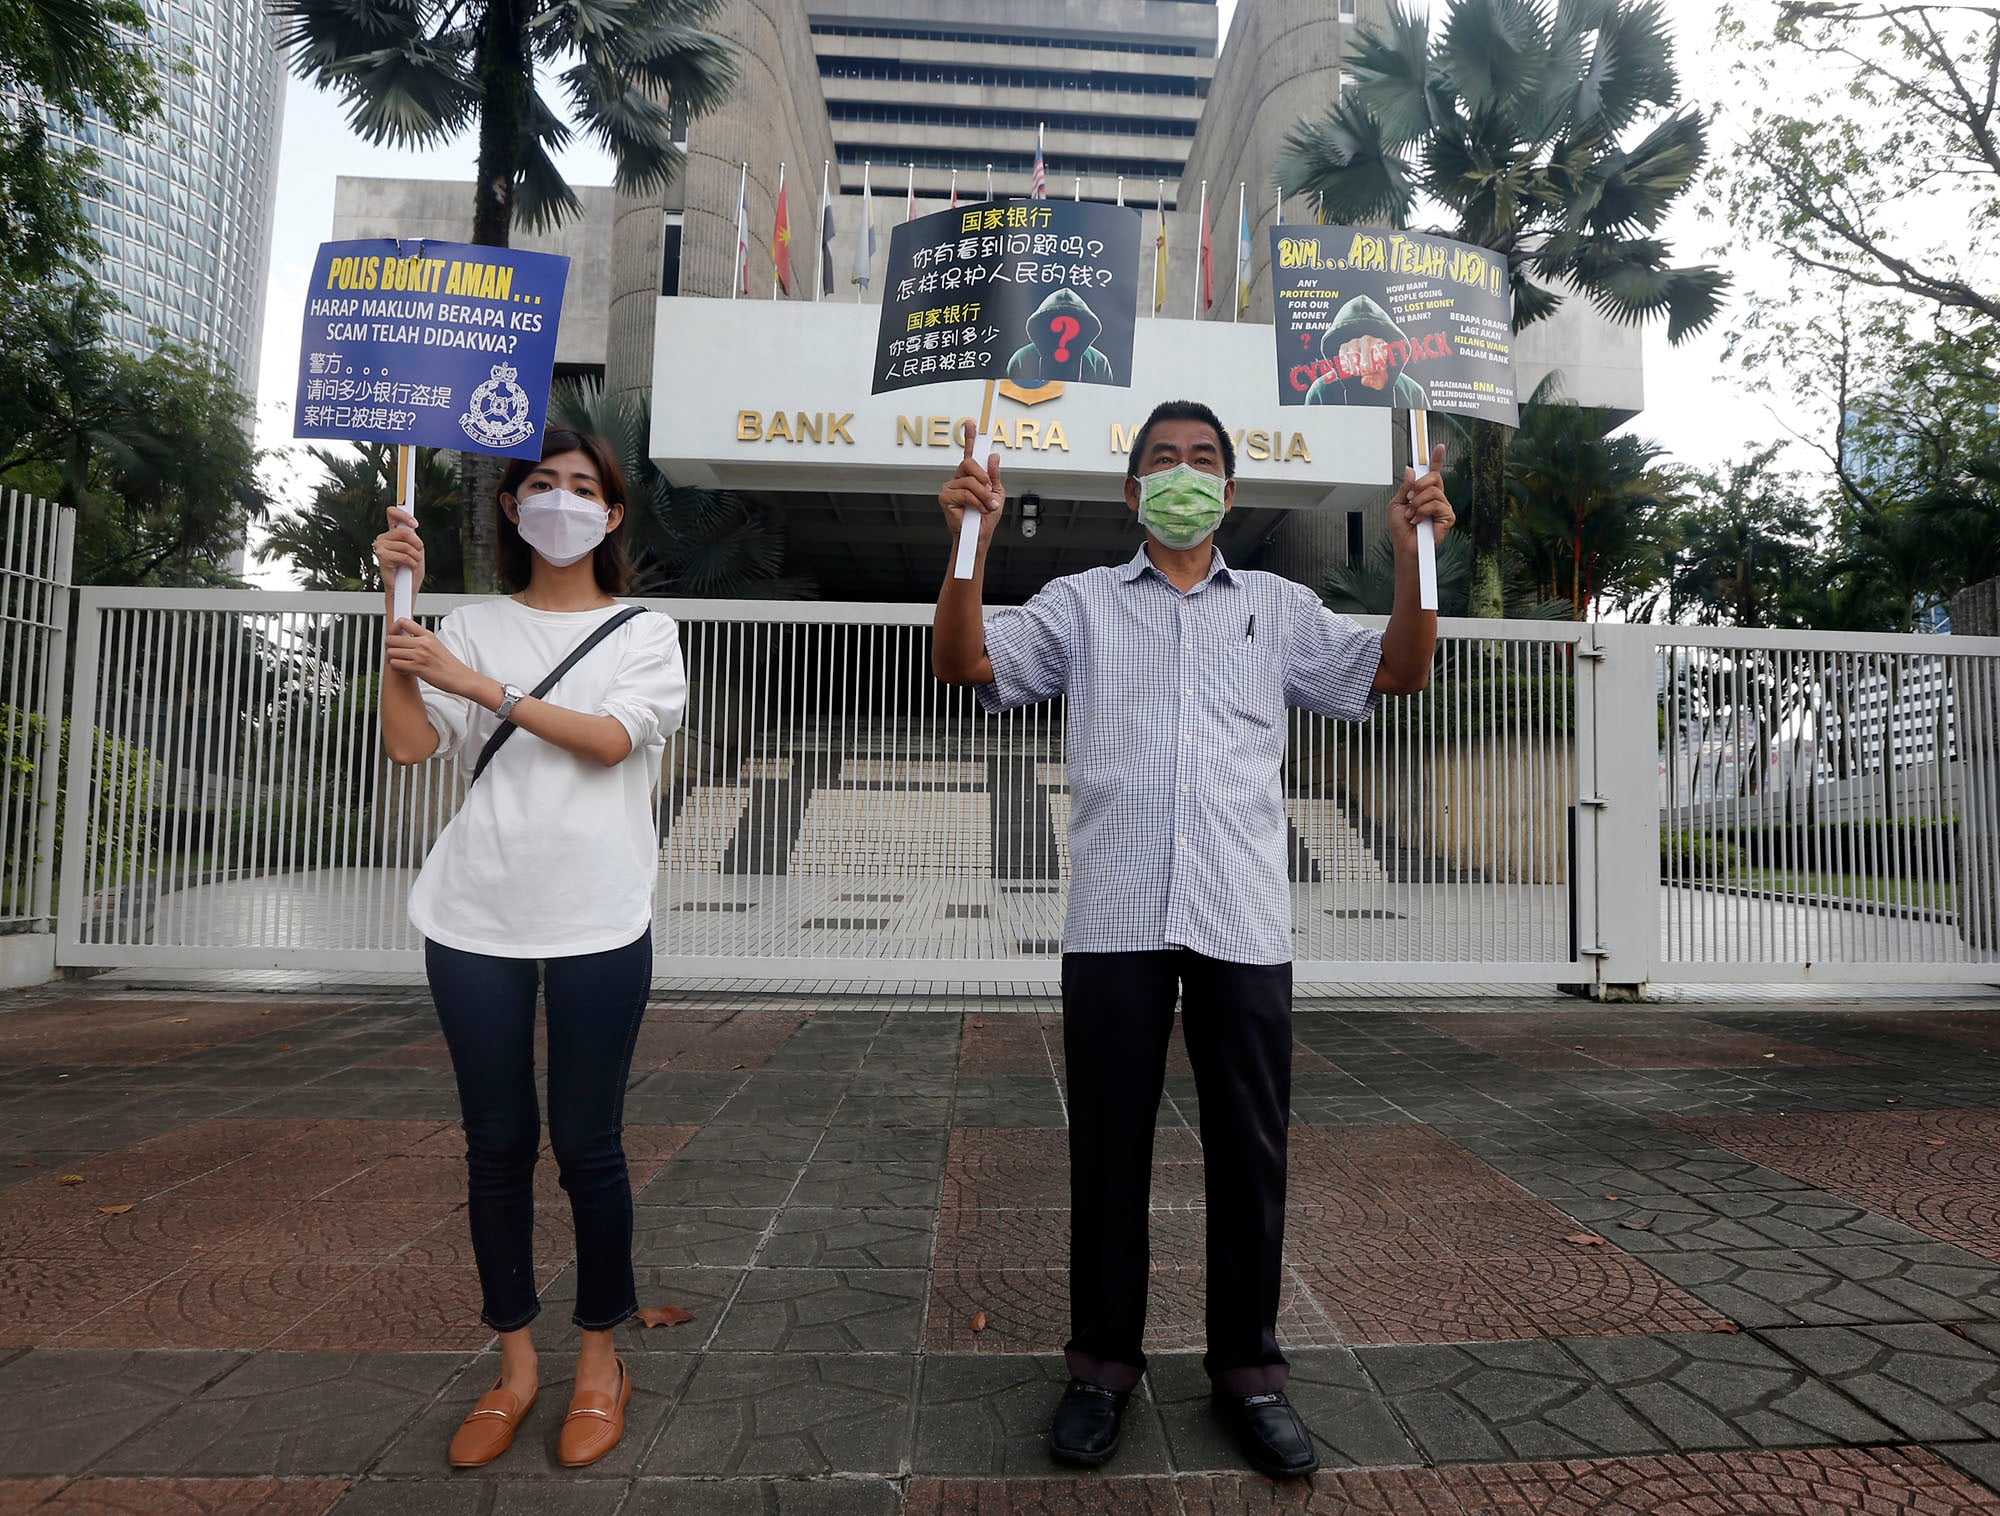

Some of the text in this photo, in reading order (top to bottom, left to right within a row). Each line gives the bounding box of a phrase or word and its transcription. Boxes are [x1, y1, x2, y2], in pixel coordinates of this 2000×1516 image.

[961, 206, 1053, 234] 国家银行
[1347, 233, 1388, 272] APA
[1389, 234, 1448, 280] TELAH
[1448, 248, 1487, 289] JADI
[327, 256, 380, 291] POLIS
[380, 256, 445, 293] BUKIT
[1297, 279, 1318, 288] ANY
[1386, 281, 1429, 294] HOW MANY
[1279, 290, 1339, 299] PROTECTION
[1389, 289, 1443, 303] PEOPLE GOING
[1288, 301, 1330, 309] FOR OUR
[1392, 299, 1456, 314] TO LOST MONEY
[310, 298, 543, 333] HARAP MAKLUM BERAPA KES
[906, 302, 981, 332] 国家银行
[1292, 311, 1328, 320] MONEY
[1395, 312, 1432, 324] IN BANK?
[1449, 312, 1509, 331] BERAPA ORANG
[1290, 322, 1303, 330] IN
[1460, 325, 1502, 341] LAGI AKAN
[326, 324, 518, 354] SCAM TELAH DIDAKWA?
[888, 325, 1001, 357] 你要看到多少
[1454, 335, 1509, 354] HILANG WANG
[1459, 347, 1509, 365] DALAM BANK
[307, 379, 452, 409] 请问多少银行盗提
[1430, 380, 1514, 397] BAGAIMANA BNM BOLEH
[1431, 390, 1511, 404] MELINDUNGI WANG KITA
[1432, 399, 1481, 410] DALAM BANK?
[735, 410, 856, 445] BANK
[1110, 423, 1313, 464] MYSIA
